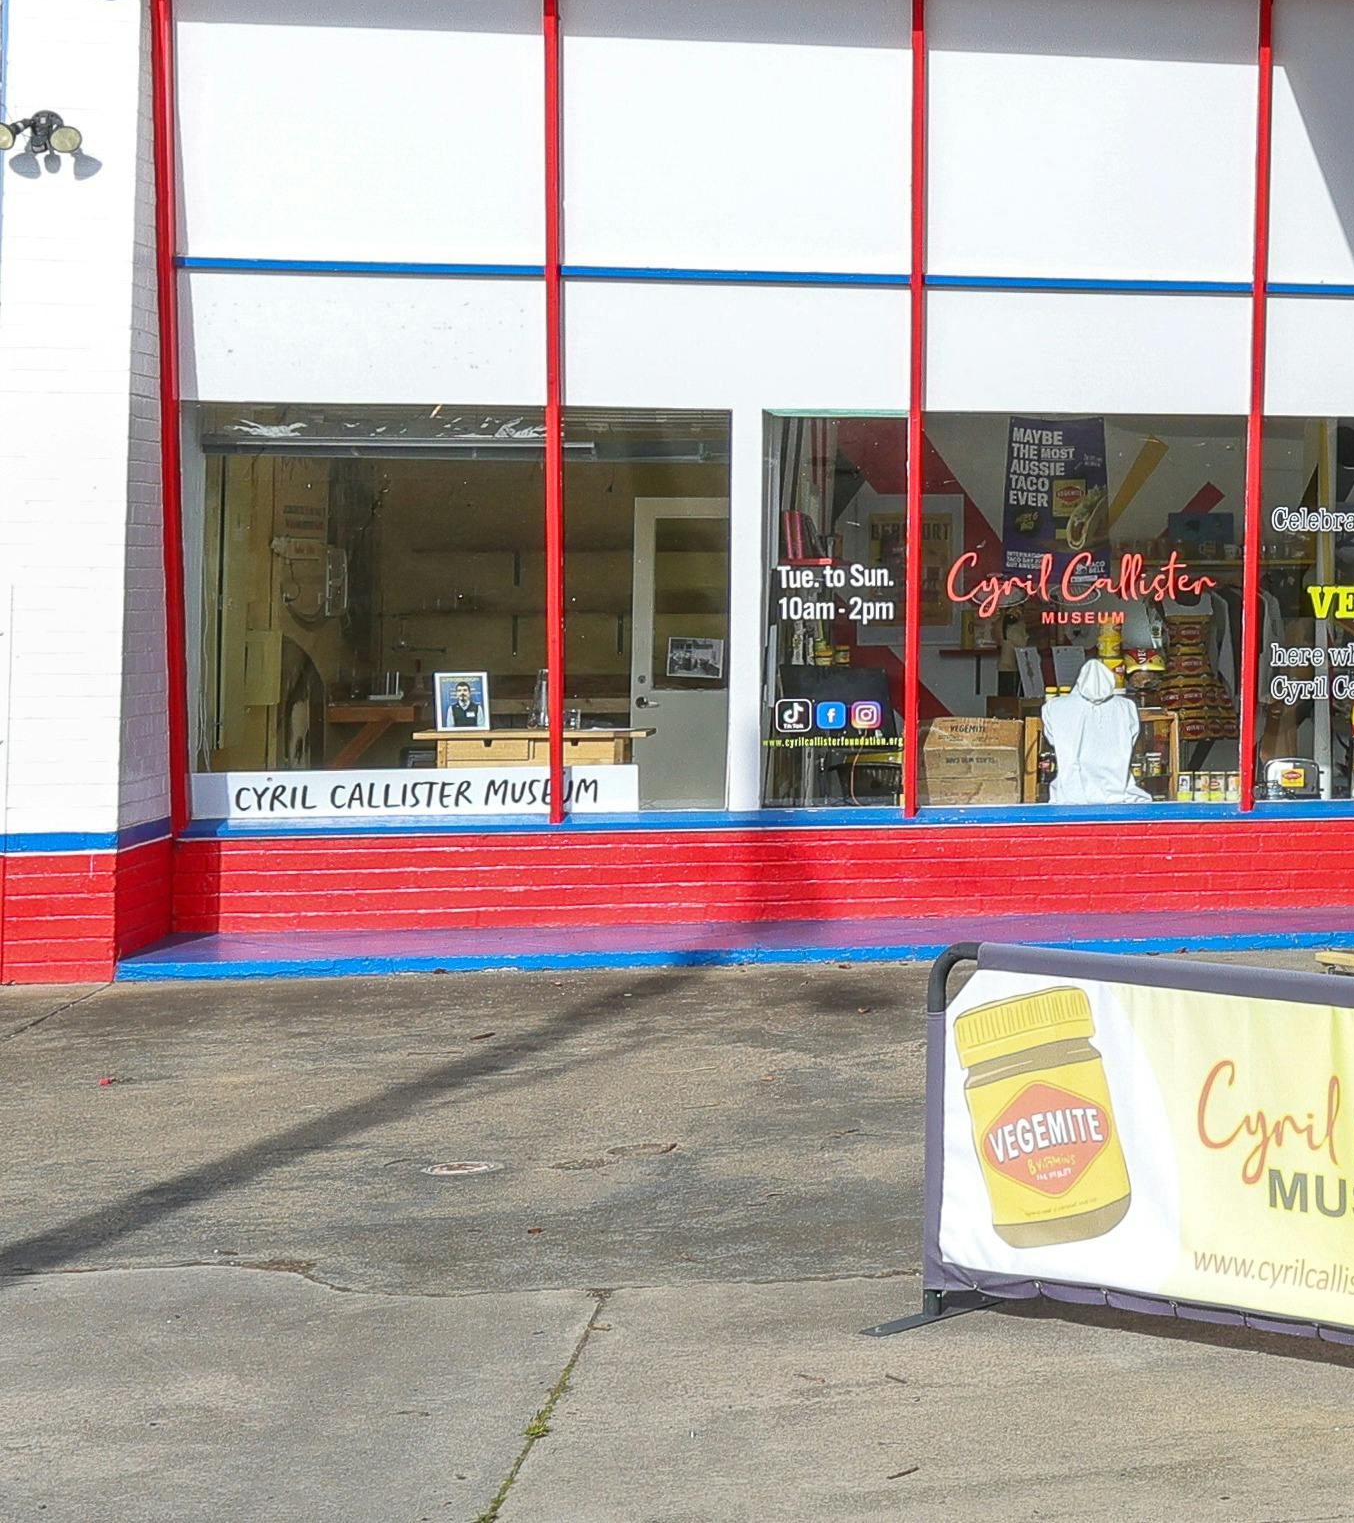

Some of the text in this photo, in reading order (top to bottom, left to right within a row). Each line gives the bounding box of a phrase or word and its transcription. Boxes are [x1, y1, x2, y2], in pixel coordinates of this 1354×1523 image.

[1012, 427, 1063, 445] MAYBE
[1011, 443, 1075, 460] THE MOST
[1010, 459, 1065, 476] AUSSIE
[1010, 474, 1050, 492] TACO
[1009, 490, 1049, 507] EVER
[777, 564, 895, 588] Tue. to Sun.
[947, 551, 1216, 617] Cyril Callister
[778, 597, 835, 620] 10am
[849, 597, 895, 625] 2pm
[1042, 611, 1125, 624] MUSEUM
[1271, 643, 1325, 667] here
[1270, 676, 1327, 705] Cyril
[235, 784, 317, 812] CYRIL
[330, 780, 474, 810] CALLISTER
[1197, 1060, 1341, 1185] Cyril
[988, 1108, 1105, 1164] VEGEMITE
